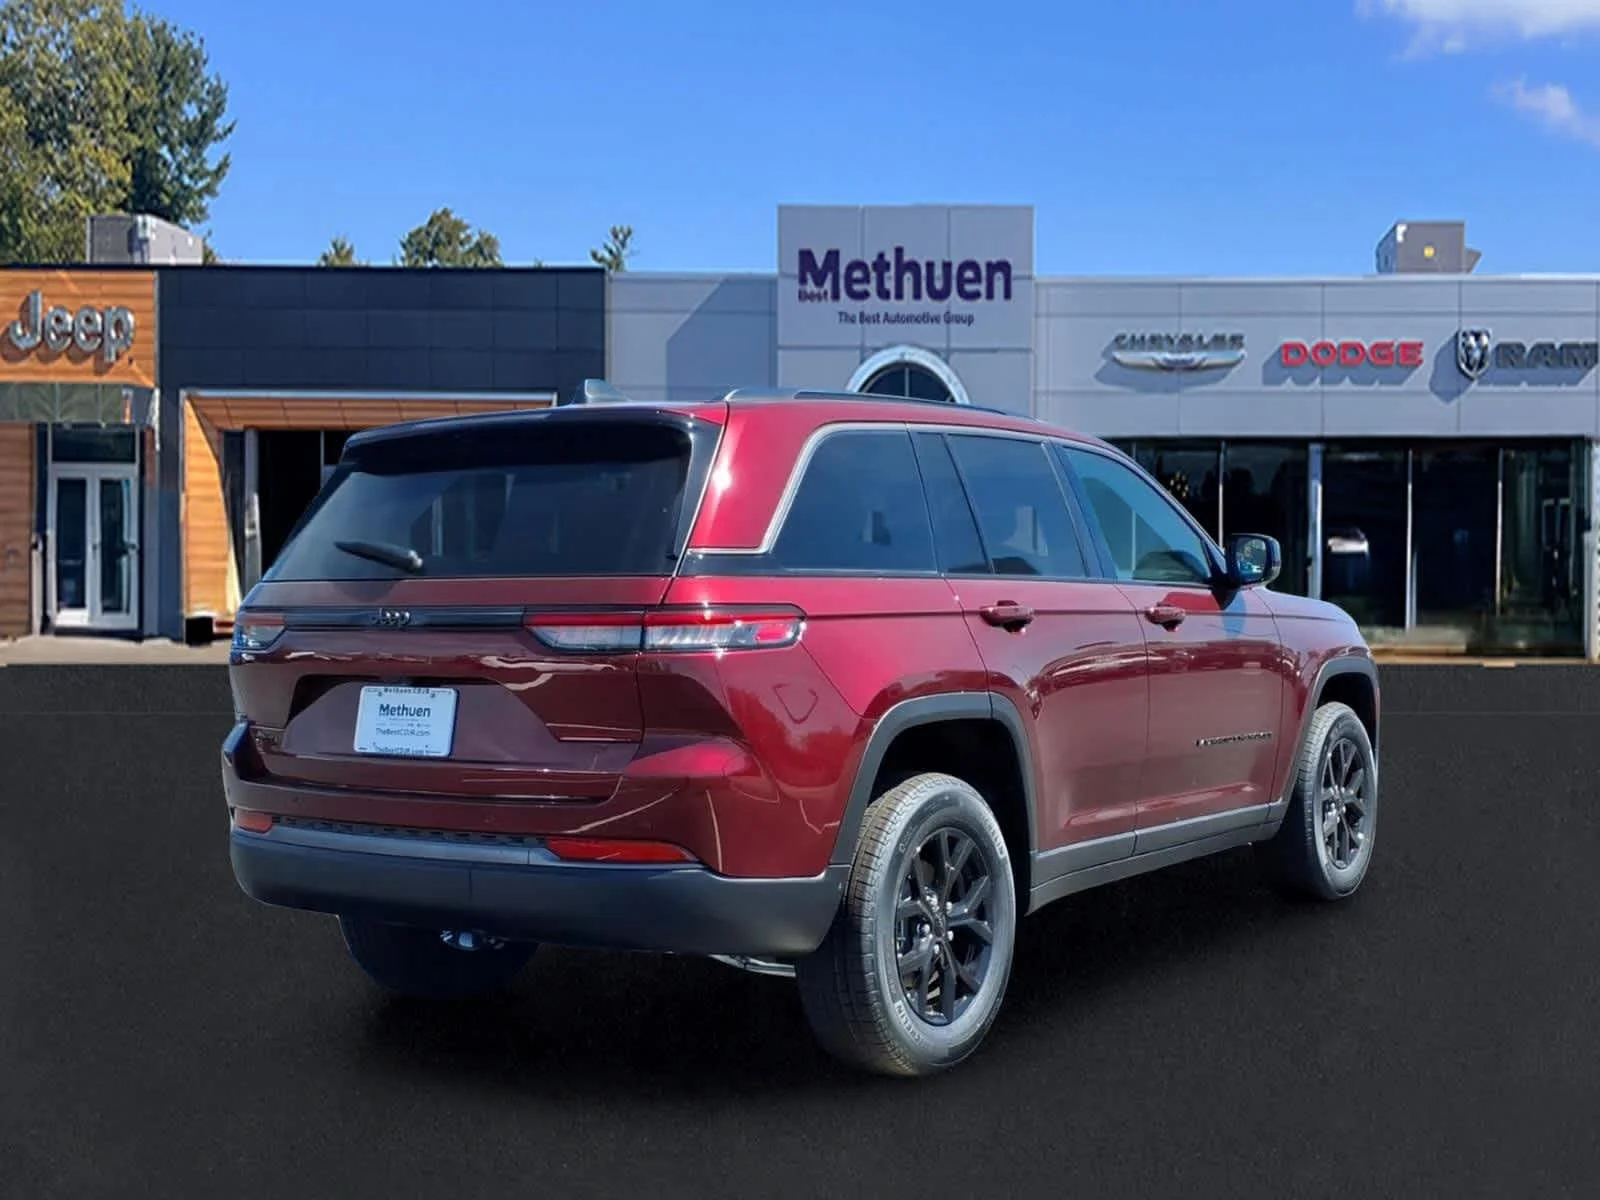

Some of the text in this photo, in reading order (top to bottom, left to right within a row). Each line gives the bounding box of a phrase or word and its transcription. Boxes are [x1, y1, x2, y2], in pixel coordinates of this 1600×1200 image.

[798, 246, 1012, 301] Methuen
[9, 290, 135, 363] Jeep
[838, 311, 974, 327] The Best Automotive Group
[1114, 333, 1245, 351] CHRYSLER
[1281, 340, 1423, 366] DODGE
[1495, 342, 1598, 369] RAM
[371, 607, 411, 629] Jeep
[379, 703, 432, 718] Methuen
